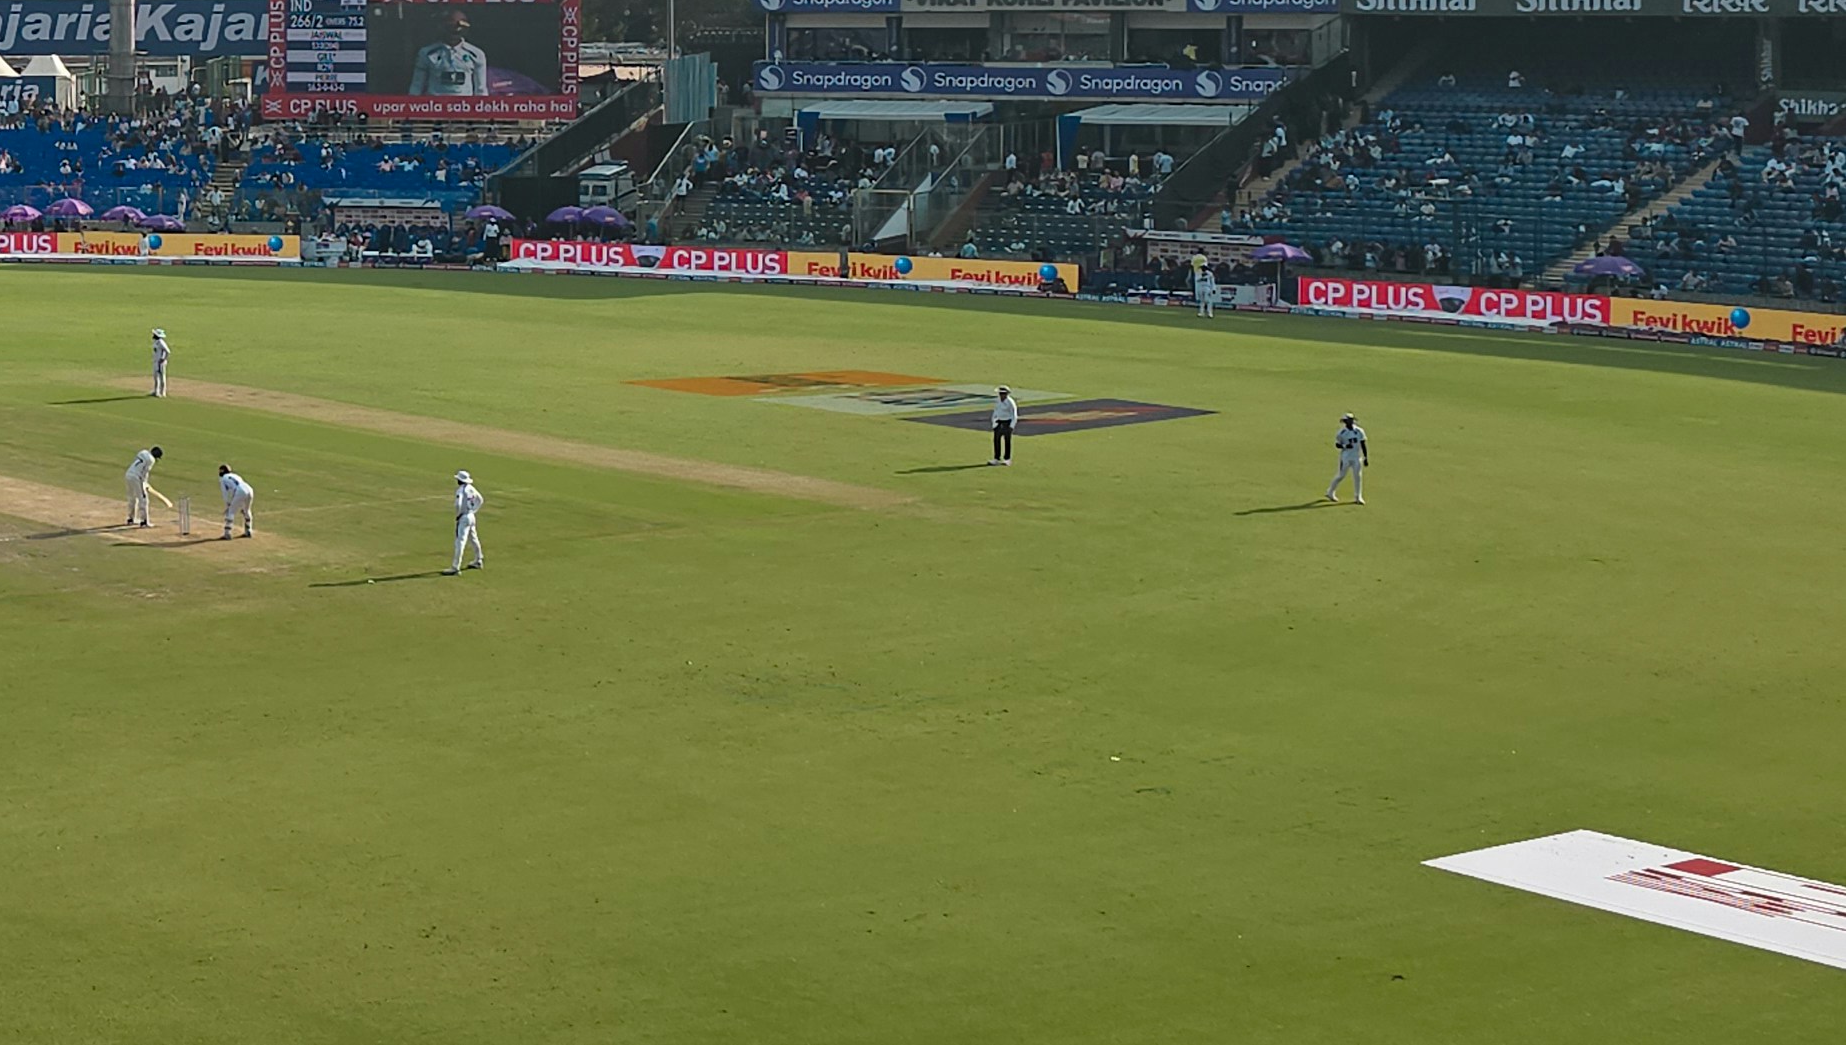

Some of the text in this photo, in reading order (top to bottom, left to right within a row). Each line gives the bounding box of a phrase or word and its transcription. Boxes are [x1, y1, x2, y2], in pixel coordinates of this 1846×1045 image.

[290, 0, 312, 12] IND
[290, 15, 323, 28] 266/2
[270, 0, 285, 68] CP PLUS
[562, 25, 577, 94] CP PLUS
[792, 71, 892, 90] Snapdragon
[933, 72, 1036, 92] Snapdragon
[1080, 74, 1183, 94] Snapdragon
[290, 99, 311, 114] CP
[373, 100, 573, 115] upar wala sab dekh raha hai
[1779, 98, 1846, 115] Shikha
[519, 243, 624, 266] CP PLUS
[673, 250, 781, 274] CP PLUS
[1308, 281, 1425, 310] CP PLUS
[1479, 292, 1602, 323] CP PLUS
